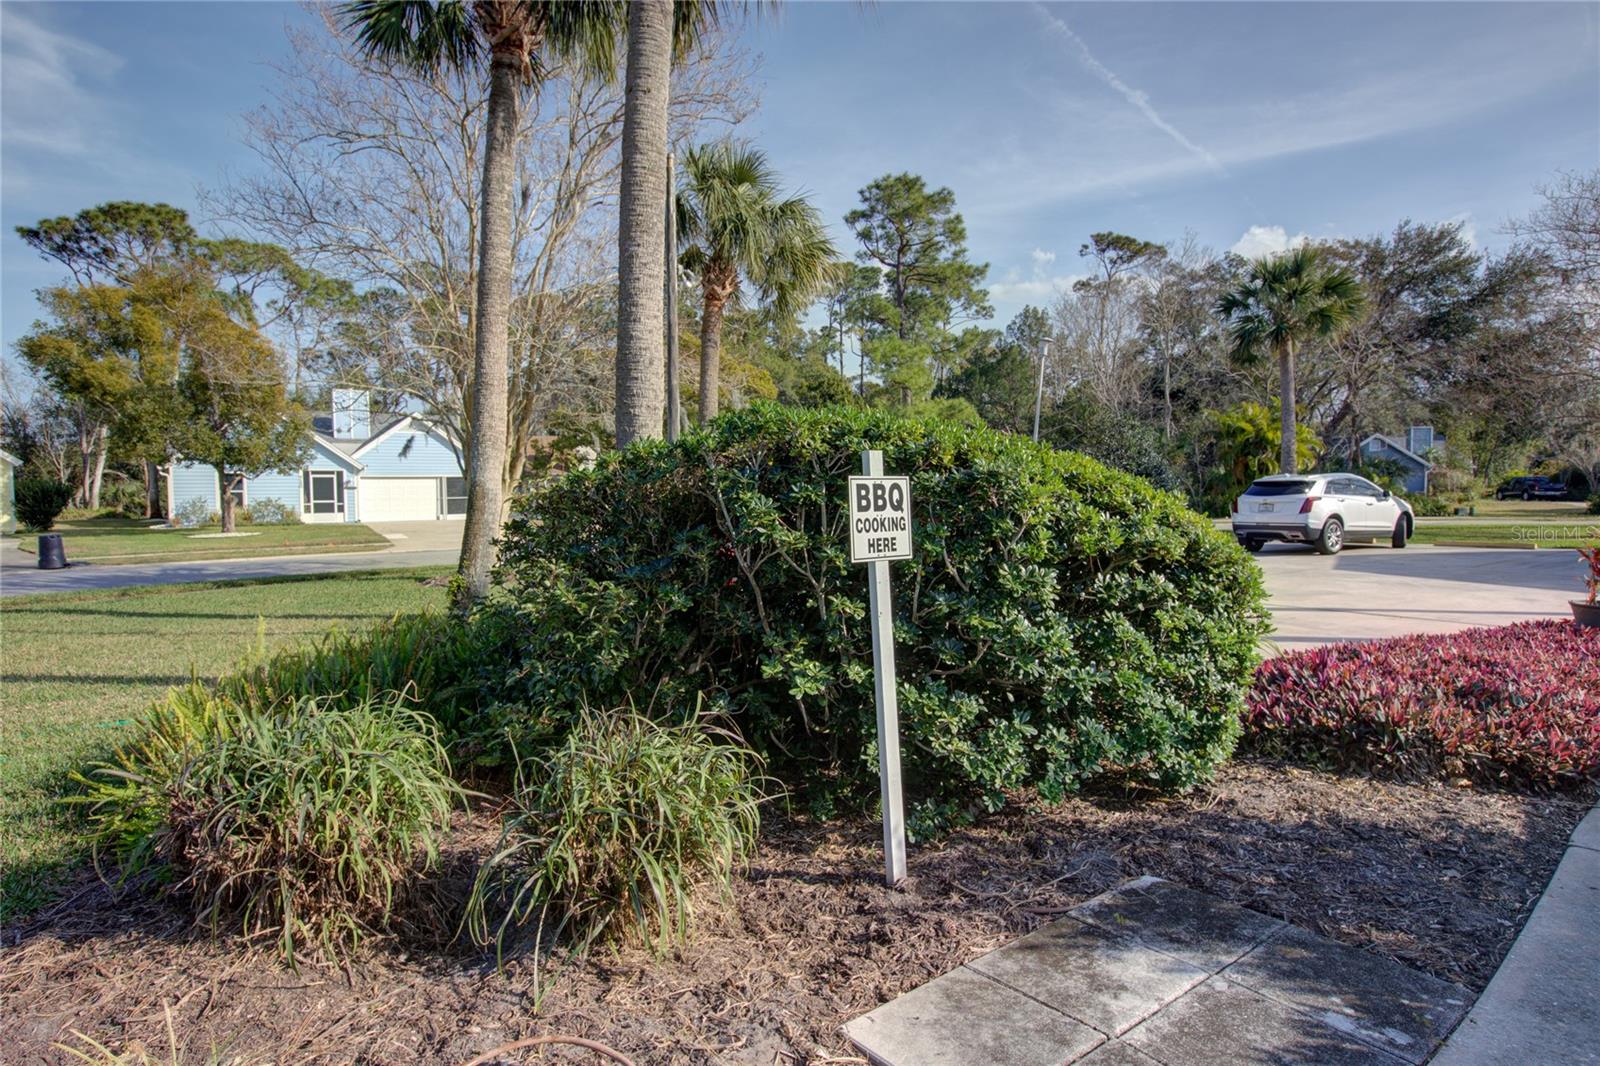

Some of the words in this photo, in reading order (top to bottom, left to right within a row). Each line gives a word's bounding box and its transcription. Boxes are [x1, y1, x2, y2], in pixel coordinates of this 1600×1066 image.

[856, 482, 904, 513] BBQ
[856, 516, 906, 534] COOKING
[868, 537, 897, 554] HERE
